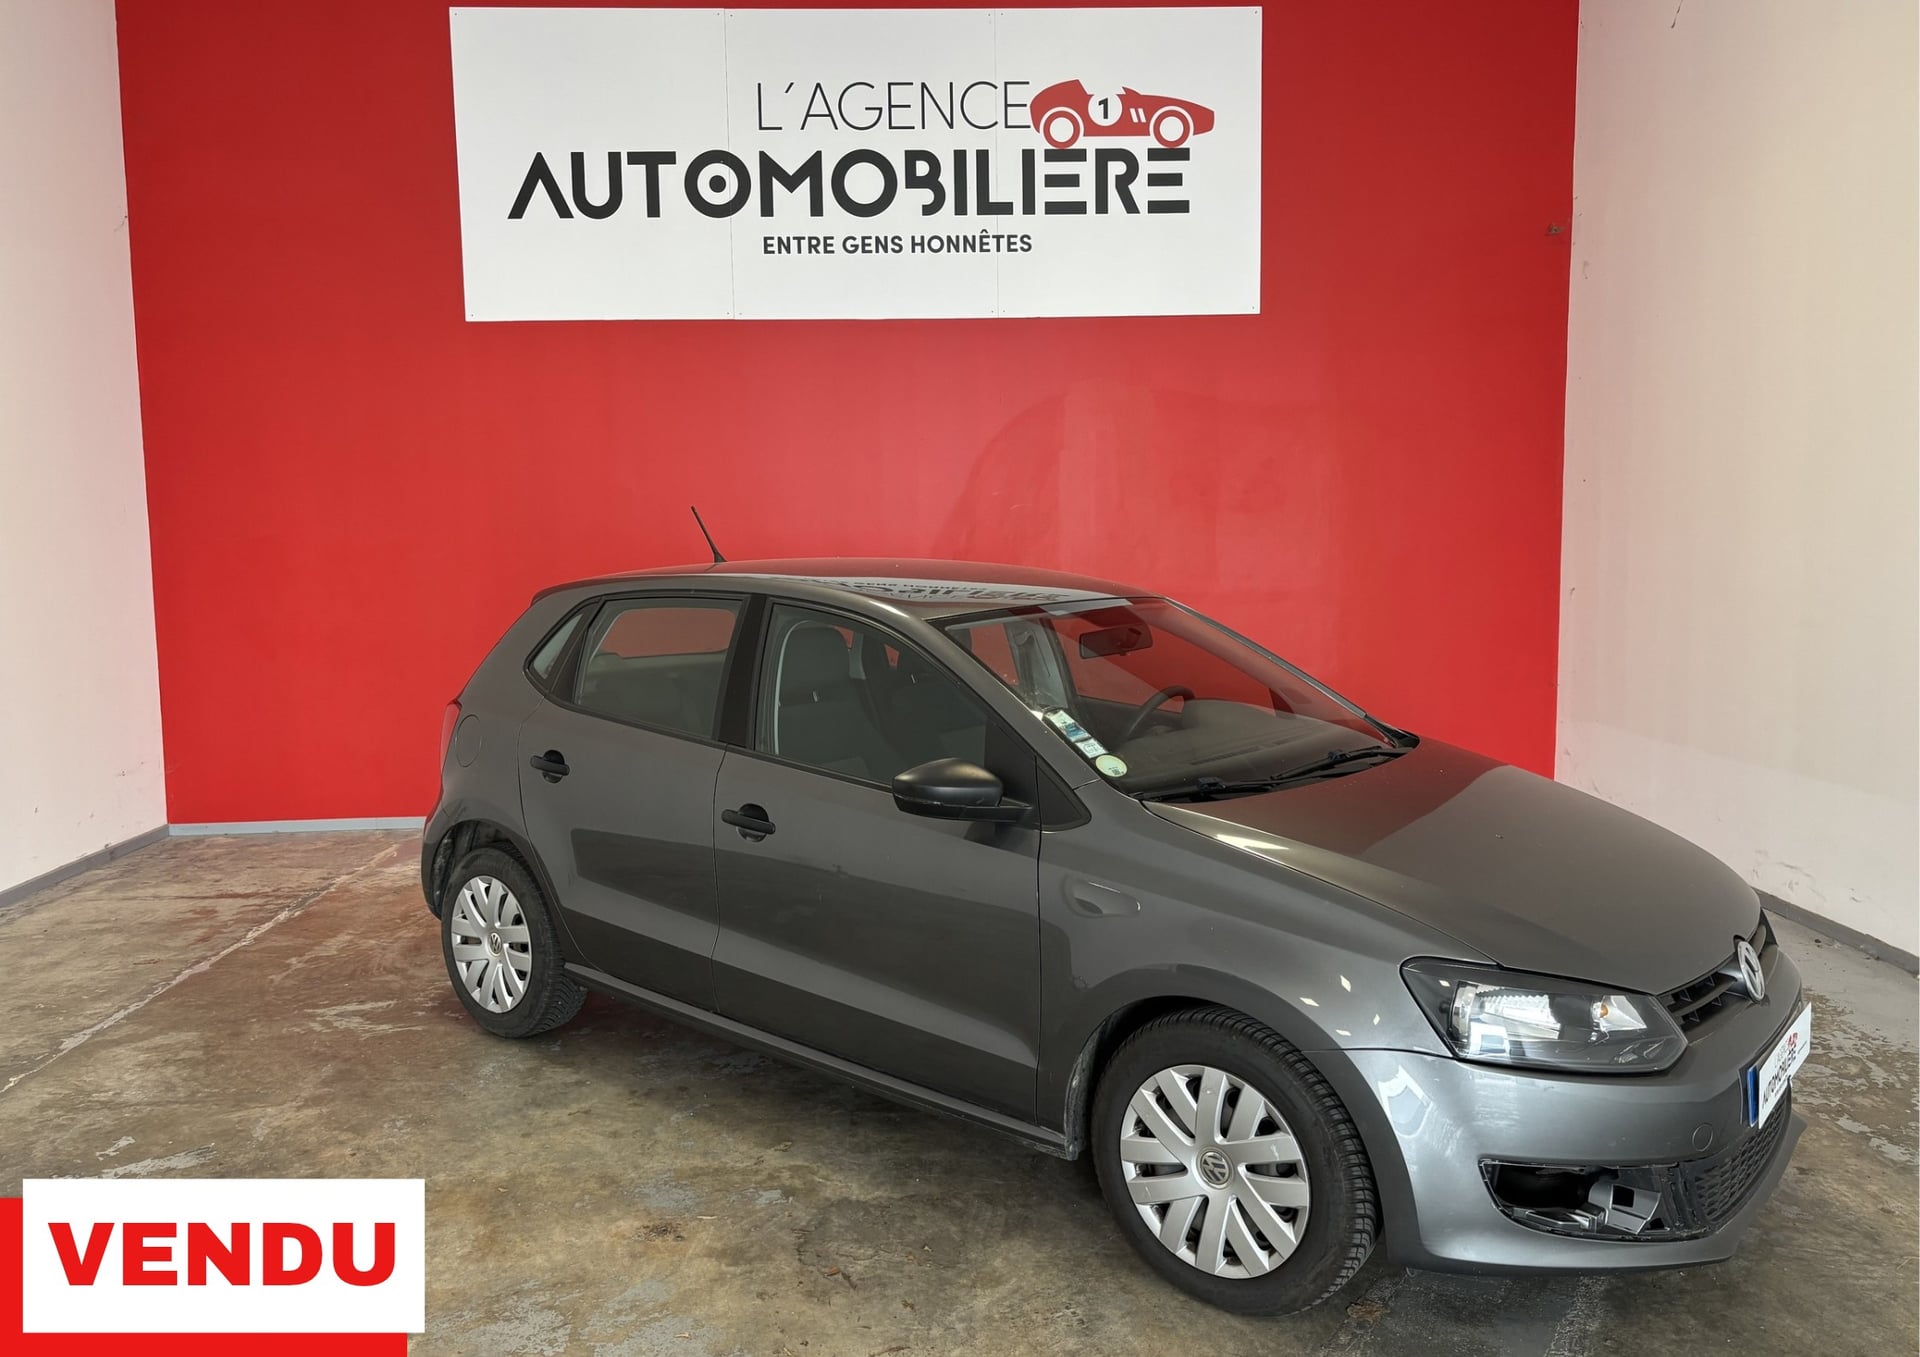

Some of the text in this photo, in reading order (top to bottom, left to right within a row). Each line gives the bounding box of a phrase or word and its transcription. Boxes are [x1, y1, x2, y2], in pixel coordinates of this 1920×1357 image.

[757, 81, 1031, 131] L'AGENCE
[1098, 97, 1109, 120] 1
[763, 228, 1032, 254] ENTRE GENS HONNÊTES
